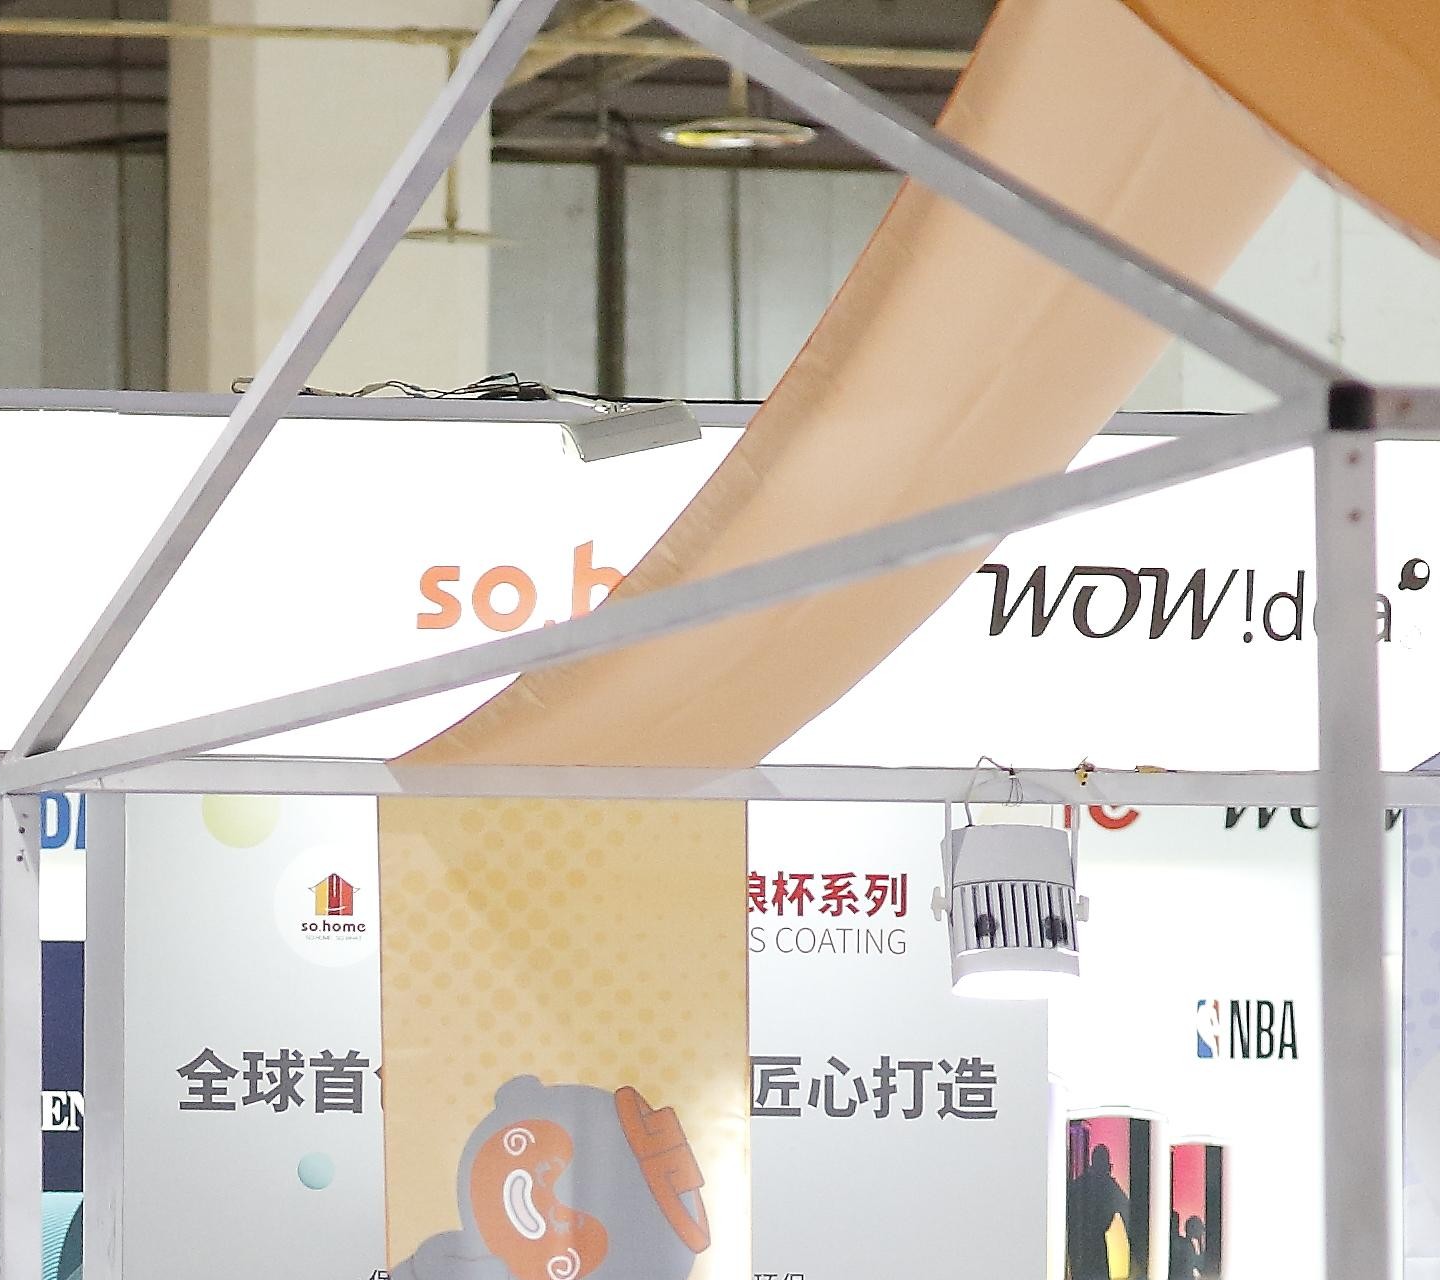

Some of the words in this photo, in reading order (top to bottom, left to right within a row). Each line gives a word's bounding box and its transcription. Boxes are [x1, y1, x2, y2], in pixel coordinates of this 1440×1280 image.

[416, 540, 626, 633] so.h
[301, 920, 366, 933] so.home
[776, 927, 907, 954] COATING
[1229, 999, 1298, 1060] NBA
[176, 1047, 384, 1114] 全球首
[749, 1055, 999, 1121] 匠心打造
